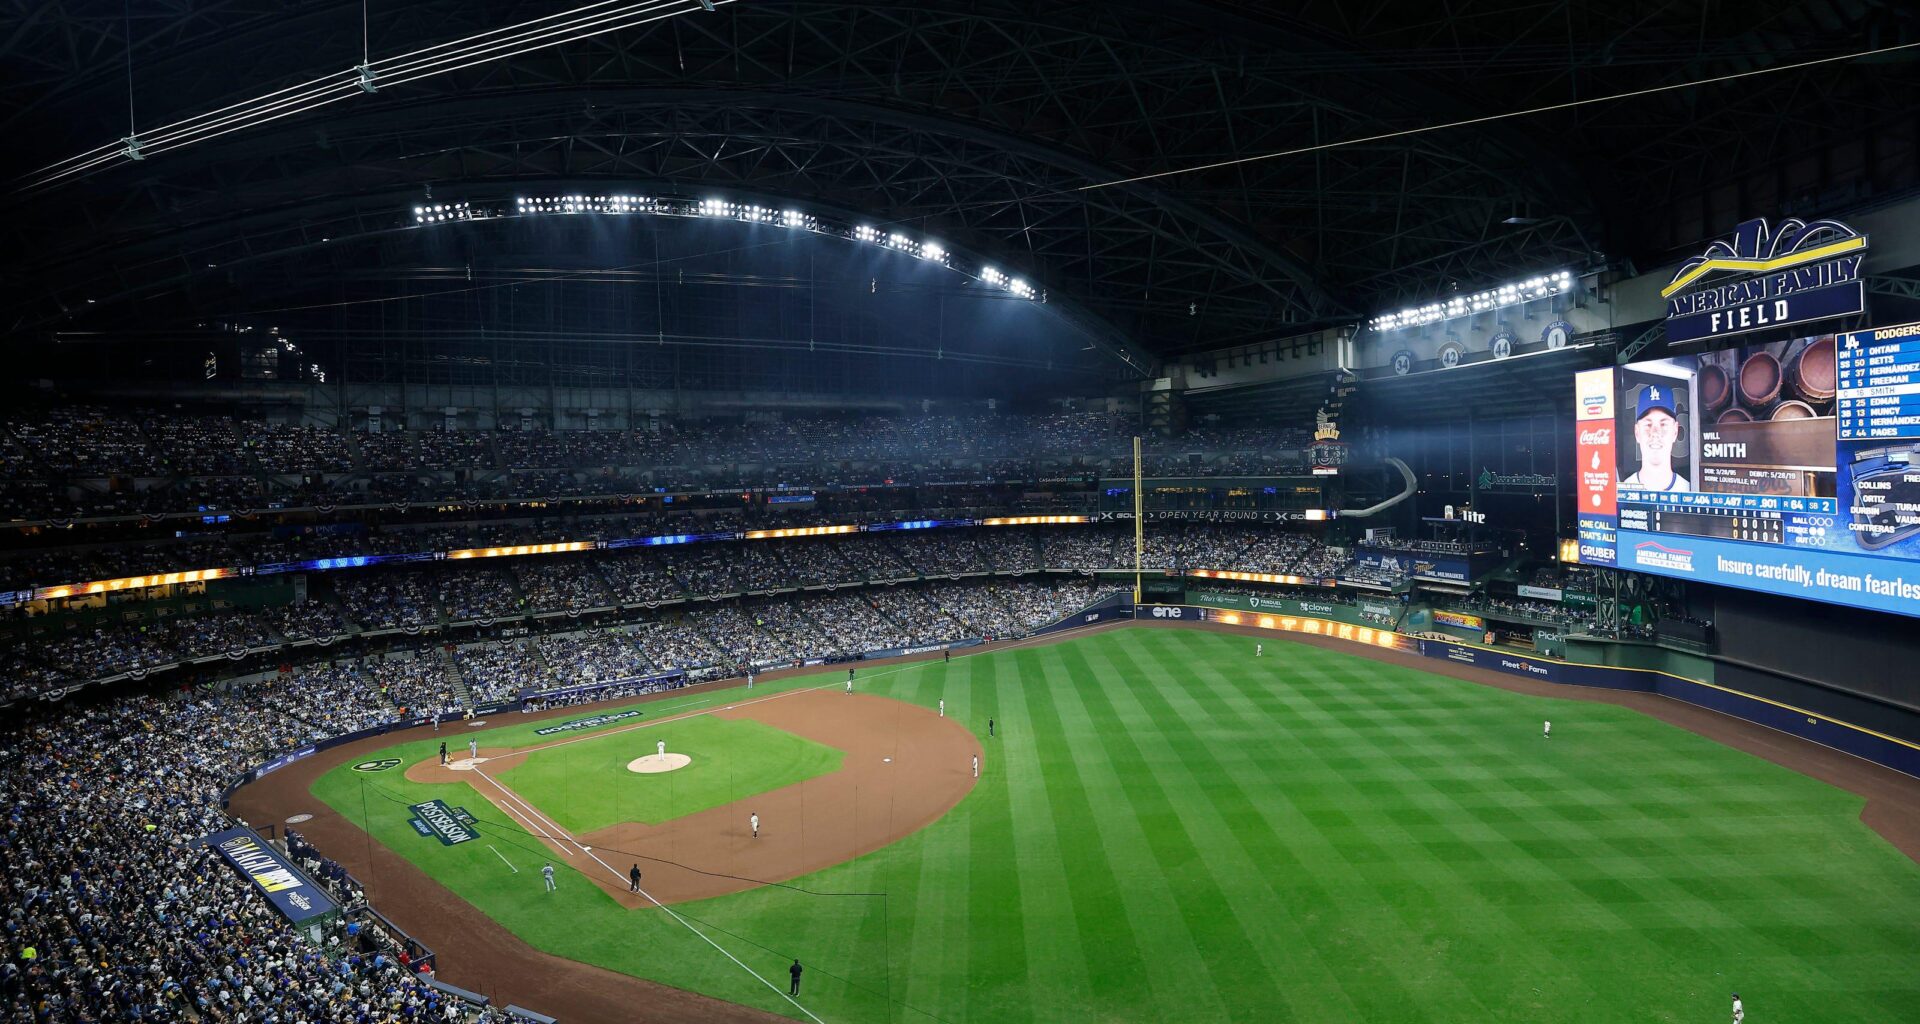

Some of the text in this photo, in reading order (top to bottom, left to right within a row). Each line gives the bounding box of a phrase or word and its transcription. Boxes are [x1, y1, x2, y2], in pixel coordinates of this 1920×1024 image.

[1668, 255, 1865, 318] AMERICAN FAMILY
[1711, 300, 1789, 332] FIELD
[1875, 326, 1920, 340] DODGERS
[1496, 343, 1509, 355] 44
[1840, 344, 1900, 359] DH 17 OHTANI
[1444, 353, 1457, 365] 42
[1840, 355, 1895, 368] SS 50 BETTS
[1841, 370, 1850, 378] RF
[1855, 369, 1865, 377] 37
[1858, 379, 1863, 387] 5
[1870, 375, 1909, 386] FREEMAN
[1871, 387, 1895, 395] SMITH
[1841, 397, 1900, 408] 2B 25 EDMAN
[1856, 409, 1865, 417] 13
[1870, 407, 1900, 416] MUNCY
[1703, 432, 1720, 440] WILL
[1841, 429, 1851, 437] CF
[1871, 428, 1898, 436] PAGES
[1703, 443, 1746, 458] SMITH
[1719, 476, 1750, 486] LOUISVILLE,
[1749, 470, 1770, 478] DEBUT:
[1770, 472, 1796, 480] 5/28/19
[1858, 481, 1892, 490] COLLINS
[1650, 494, 1657, 502] 17
[1670, 494, 1678, 503] 61
[1760, 498, 1777, 508] .901
[1790, 499, 1804, 510] 64
[1809, 502, 1818, 510] SB
[1822, 502, 1830, 512] 2
[1862, 494, 1886, 503] ORTIZ
[1160, 511, 1188, 519] OPEN
[1192, 511, 1220, 519] YEAR
[1223, 511, 1258, 520] ROUND
[1850, 506, 1880, 515] DURBIN
[1463, 510, 1486, 524] lite
[1580, 520, 1594, 528] ONE
[1849, 523, 1895, 533] CONTRERAS
[1580, 531, 1616, 543] THAT'S ALL!
[1580, 546, 1615, 559] GRUBER
[1637, 550, 1691, 563] AMERICAN FAMILY
[1437, 571, 1464, 580] MILWAUKEE
[1717, 555, 1753, 576] Insure
[1756, 563, 1813, 587] carefully,
[1816, 568, 1862, 592] dream
[1565, 593, 1586, 601] POWER
[1308, 604, 1333, 613] clover
[1363, 603, 1391, 616] Johnsonville
[1261, 617, 1393, 648] STRIKES
[1538, 630, 1558, 641] Pick
[910, 645, 941, 654] POSTSEASON
[1502, 660, 1548, 675] Fleet Farm
[417, 801, 471, 843] POSTSEASON
[223, 842, 282, 875] MAGIC
